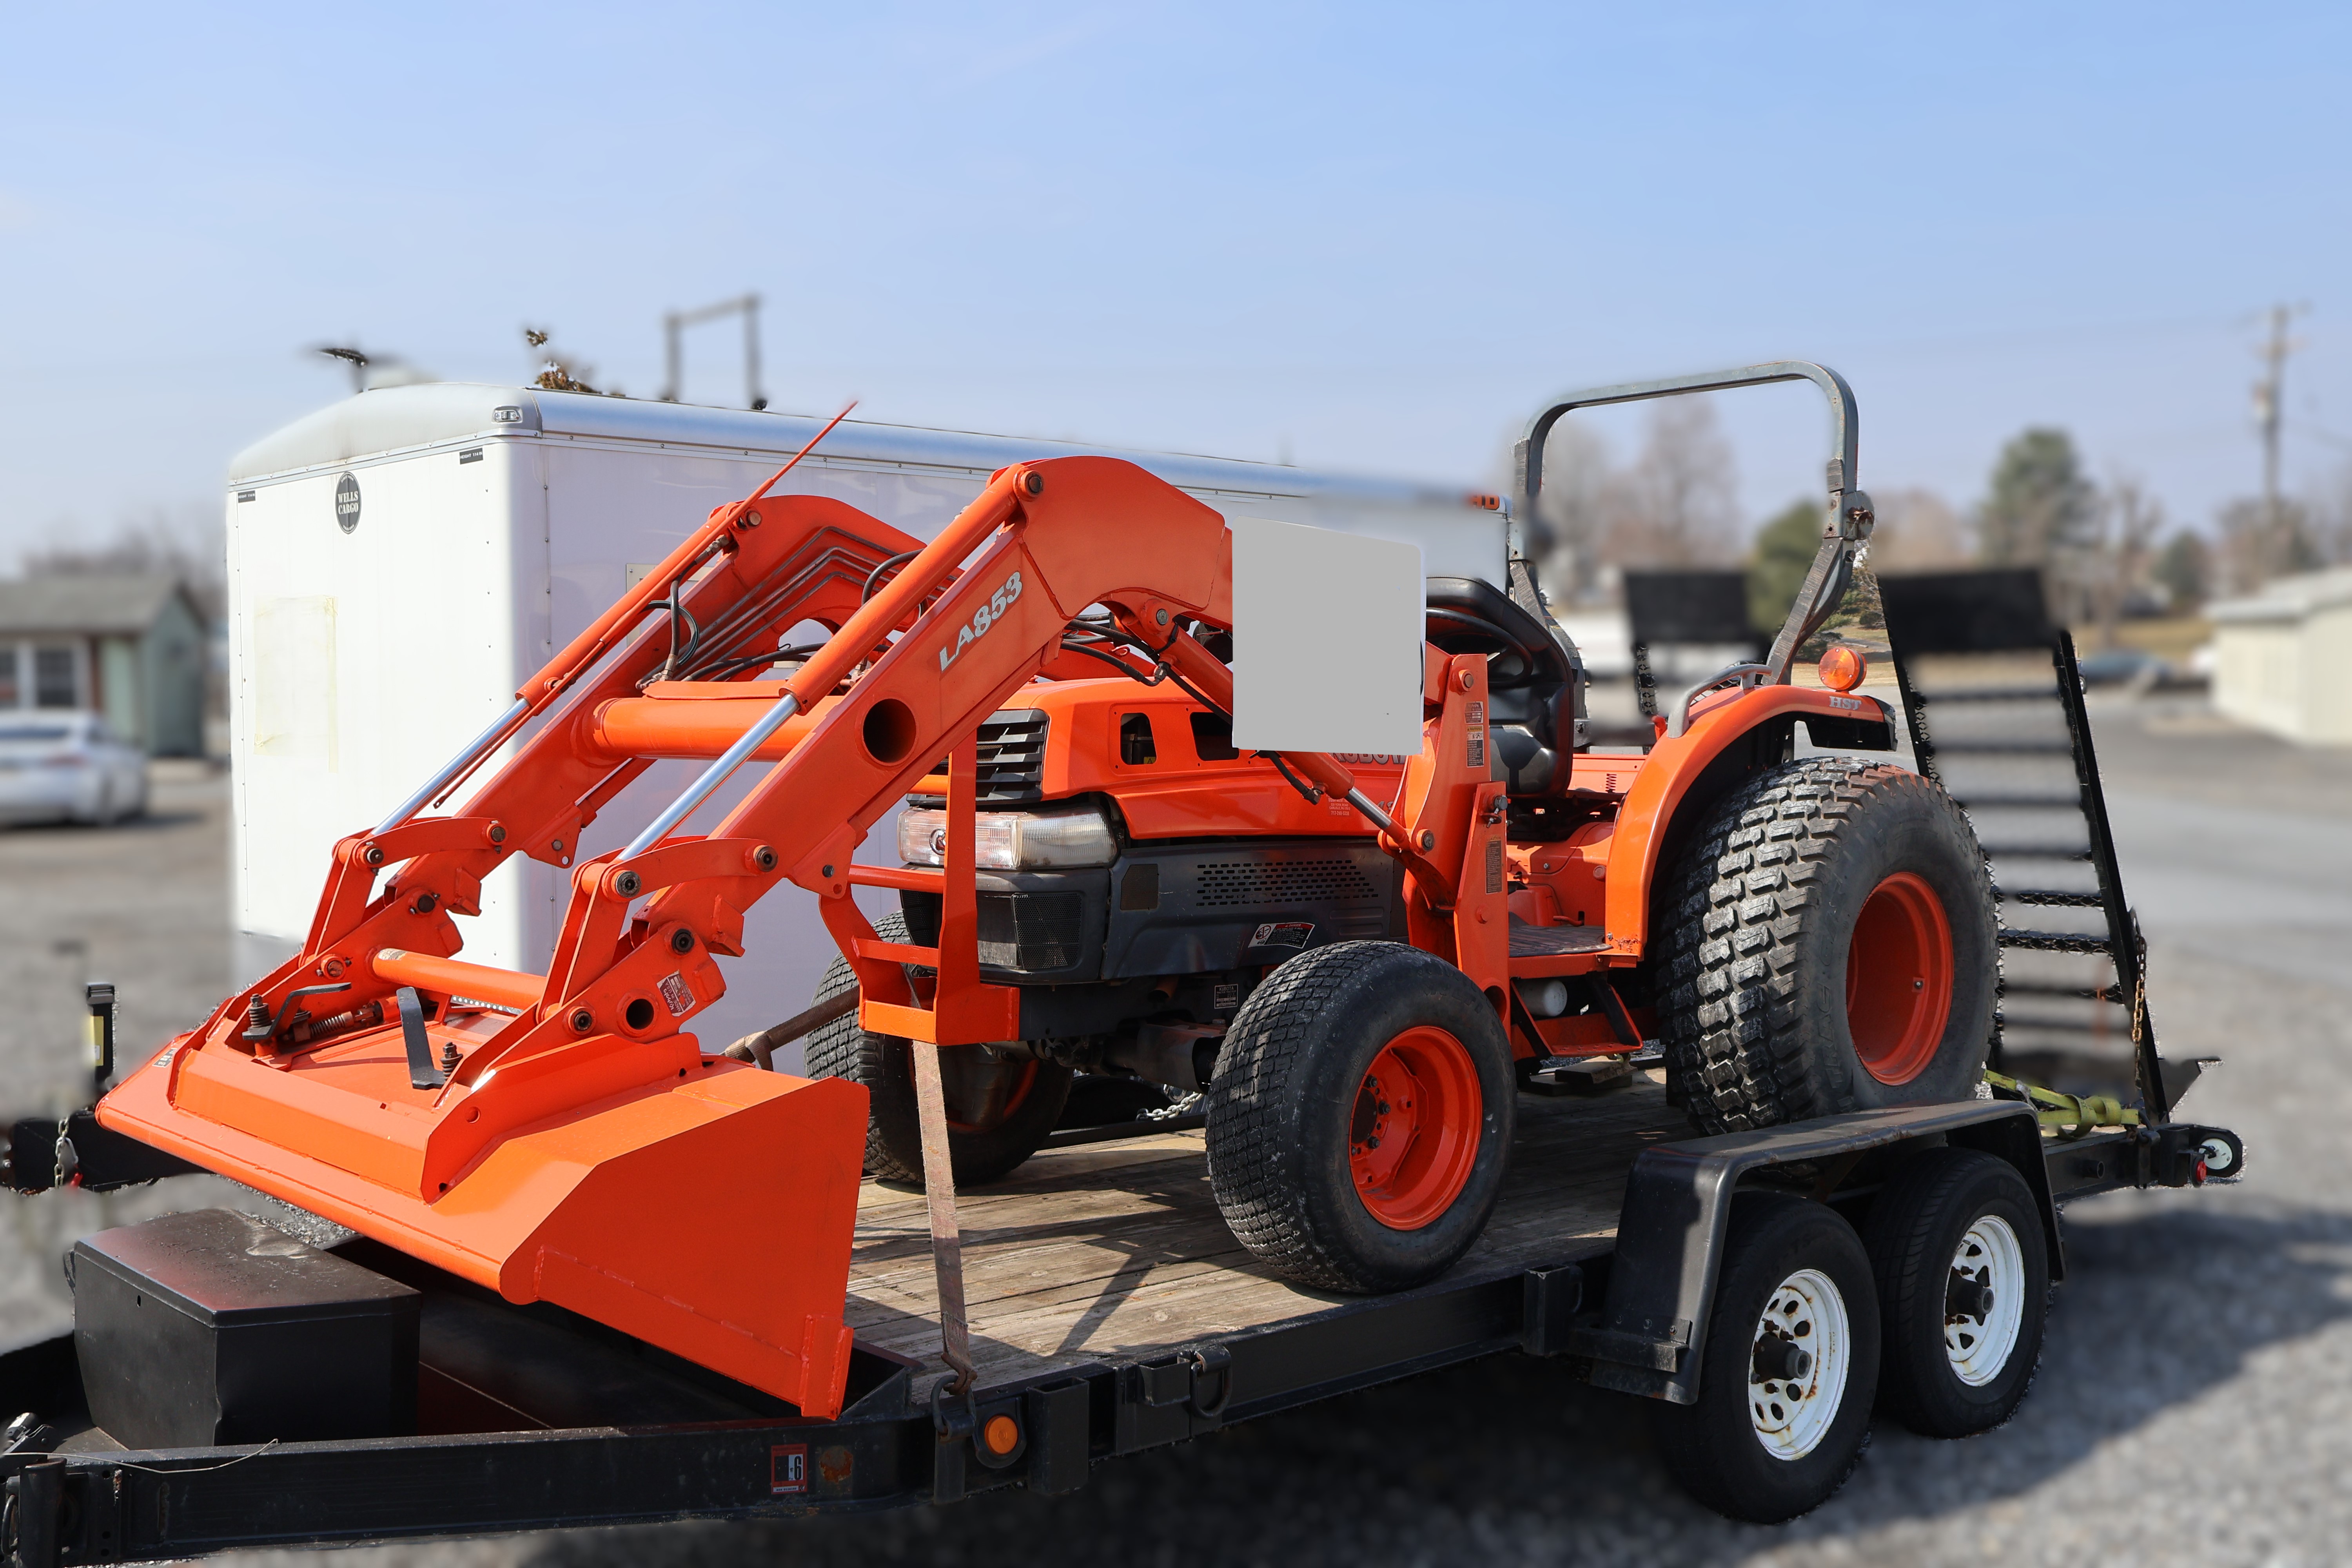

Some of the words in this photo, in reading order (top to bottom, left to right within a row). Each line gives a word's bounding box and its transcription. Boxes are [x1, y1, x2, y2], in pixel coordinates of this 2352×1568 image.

[338, 491, 358, 503] WELLS
[338, 503, 359, 515] CARGO
[940, 572, 1022, 672] LA853
[1829, 696, 1862, 710] HST
[663, 988, 674, 1010] Kubota
[794, 1456, 802, 1480] 6
